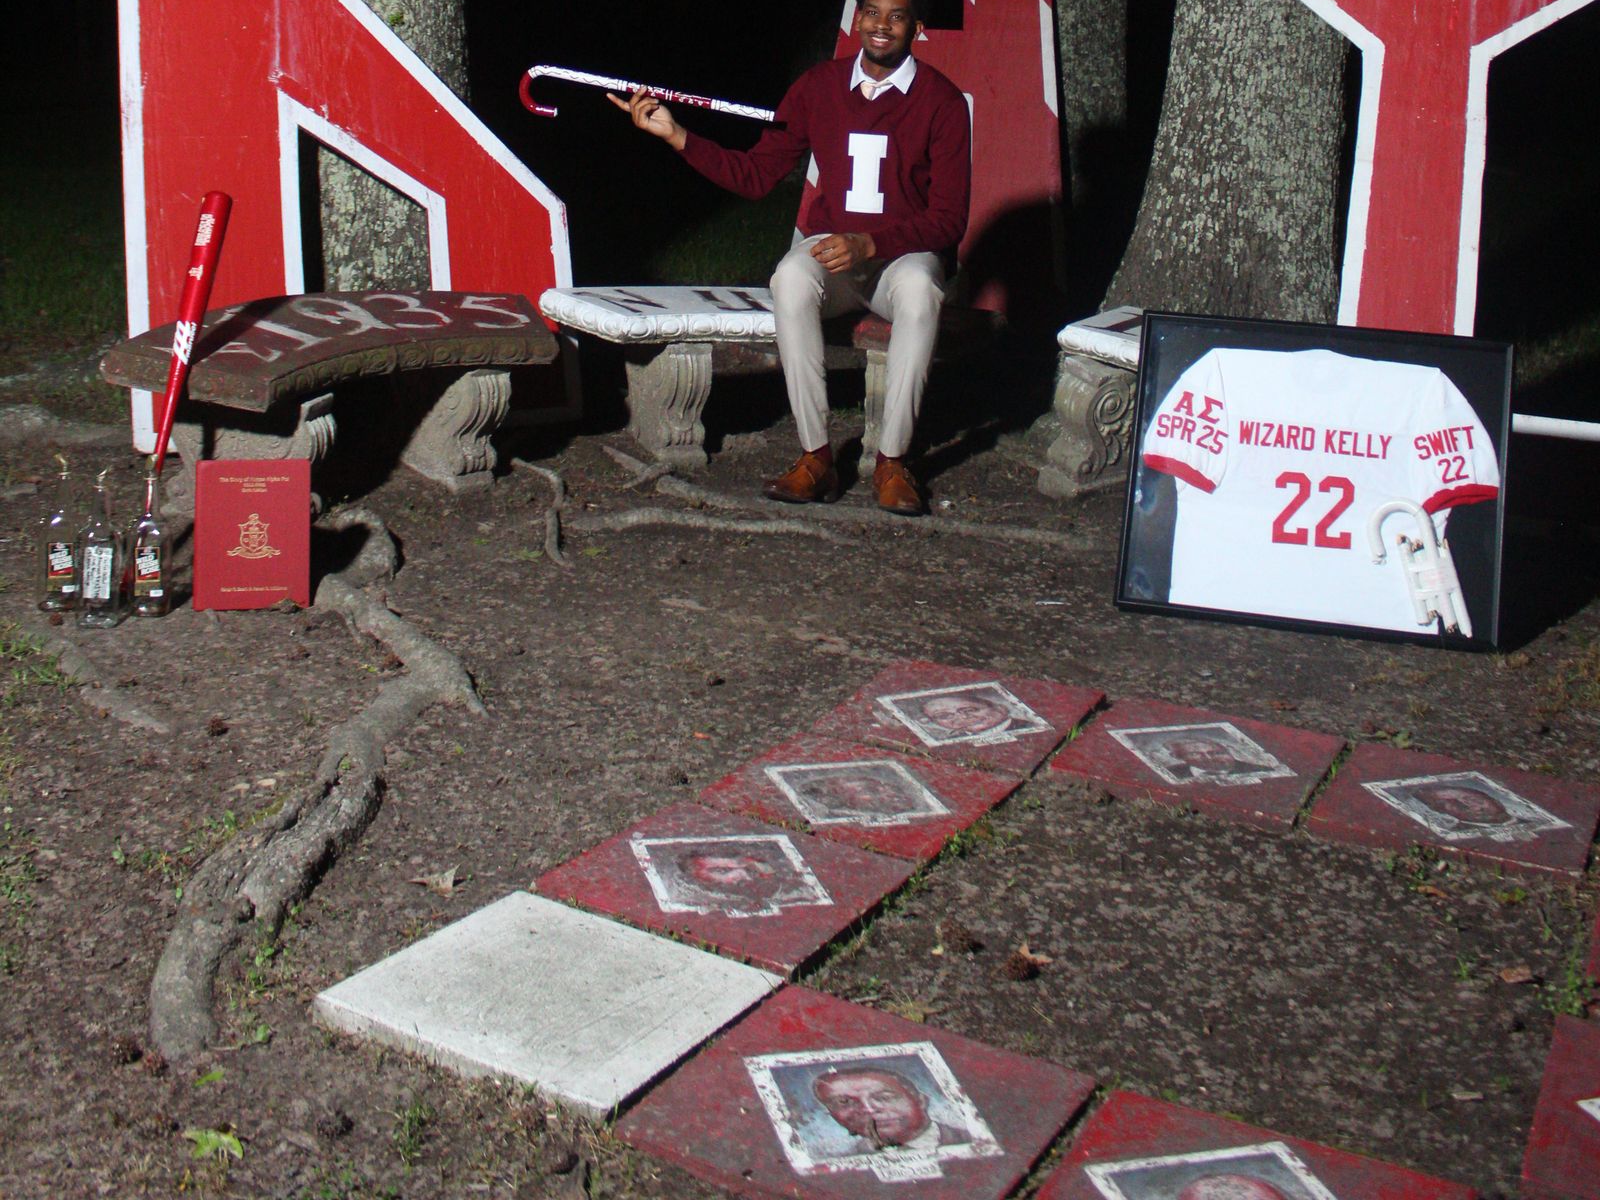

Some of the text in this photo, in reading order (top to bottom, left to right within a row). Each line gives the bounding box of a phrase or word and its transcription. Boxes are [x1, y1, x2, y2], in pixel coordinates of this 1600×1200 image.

[845, 132, 888, 214] I
[216, 293, 530, 351] 1935
[1156, 413, 1230, 455] SPR 25
[1239, 420, 1393, 460] WIZARD KELLY
[1413, 425, 1475, 461] SWIFT
[1437, 455, 1470, 485] 22
[1271, 471, 1356, 550] 22
